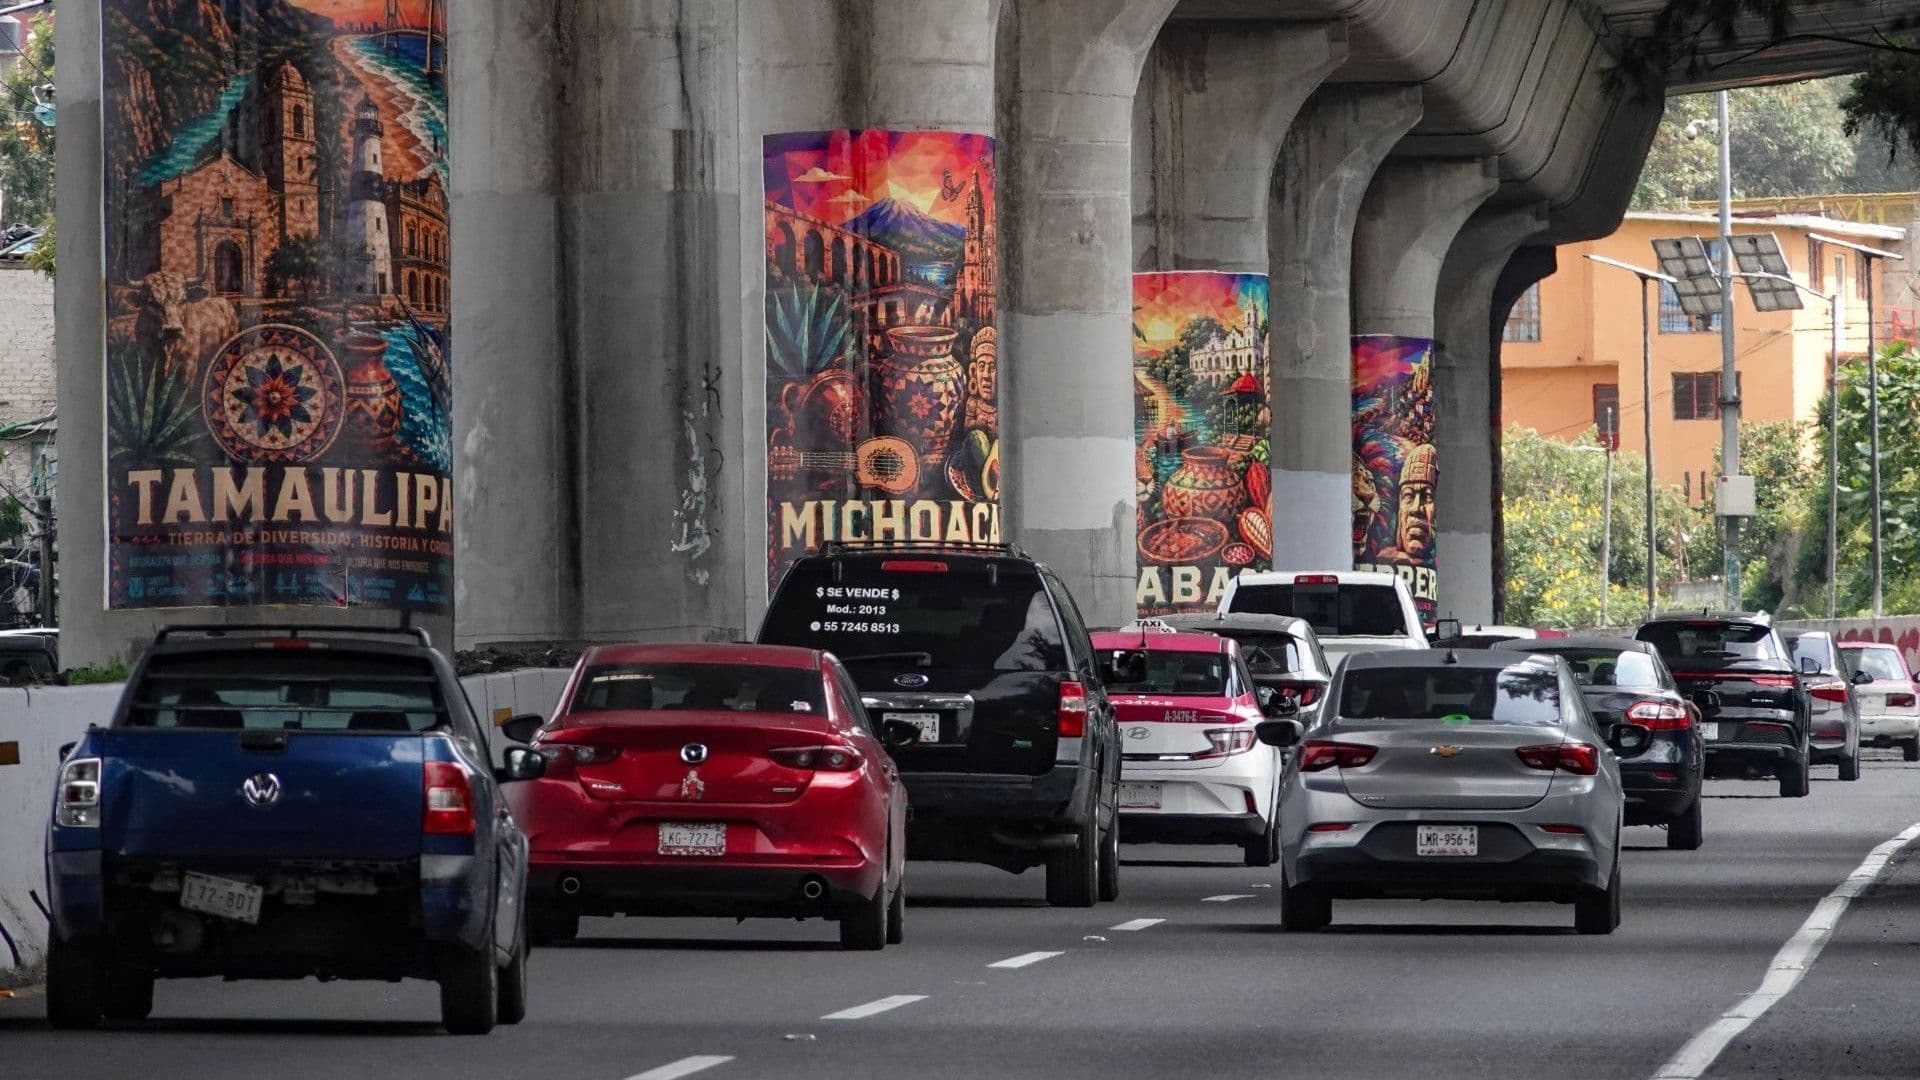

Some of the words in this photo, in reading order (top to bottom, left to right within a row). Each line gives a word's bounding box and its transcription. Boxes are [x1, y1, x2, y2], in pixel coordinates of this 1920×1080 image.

[128, 467, 452, 533] TAMAULIPA
[781, 499, 1000, 549] MICHOACA
[168, 531, 226, 546] TIERRA
[234, 530, 256, 545] DE
[360, 534, 418, 552] HISTORIA
[422, 538, 428, 552] Y
[1136, 564, 1271, 604] ABA
[1359, 563, 1438, 602] RER
[827, 587, 843, 597] SE
[845, 588, 890, 599] VENDE
[826, 604, 856, 614] Mod.:
[858, 605, 886, 615] 2013
[824, 621, 838, 631] 55
[841, 621, 868, 632] 7245
[870, 622, 900, 633] 8513
[1135, 620, 1161, 628] TAXI
[1164, 710, 1198, 722] A-3476-E
